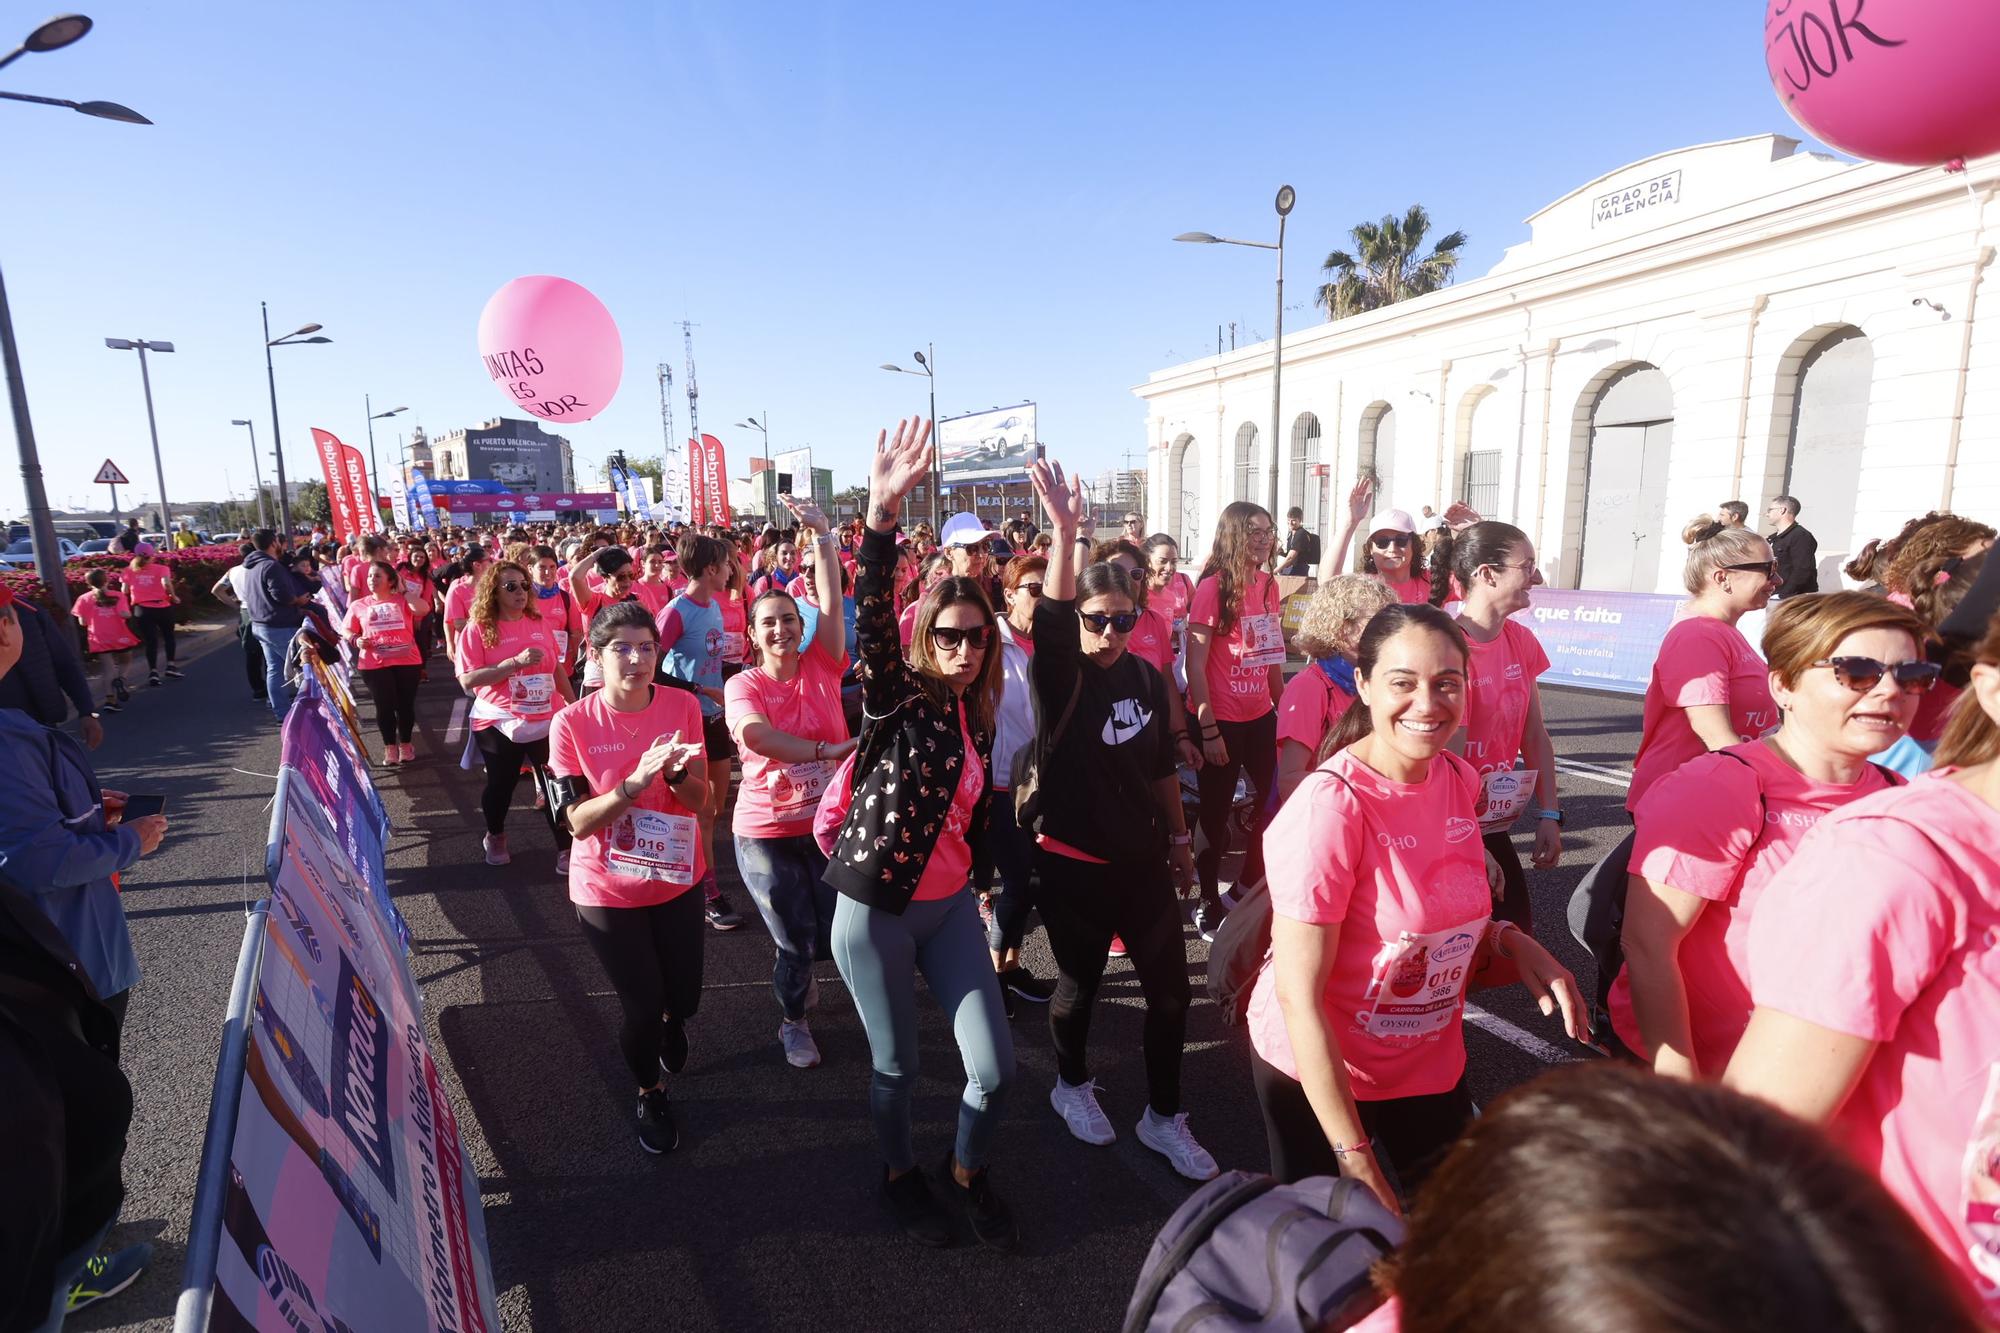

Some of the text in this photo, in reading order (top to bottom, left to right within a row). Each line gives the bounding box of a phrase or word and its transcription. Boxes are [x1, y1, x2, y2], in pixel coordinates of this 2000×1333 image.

[1649, 177, 1672, 194] DE
[1597, 190, 1673, 222] VALENCIA
[508, 381, 536, 399] ES
[481, 438, 506, 446] PUERTO
[1533, 605, 1623, 625] que falta
[1746, 711, 1768, 728] TU
[588, 742, 625, 755] OYSHO
[795, 777, 819, 792] 016
[1490, 800, 1512, 811] 016
[637, 838, 665, 852] 016
[618, 856, 640, 865] CARRERA
[641, 850, 659, 860] 3605
[1428, 966, 1462, 988] 016
[1390, 1005, 1424, 1014] CARRERA
[1380, 1019, 1421, 1029] OYSHO
[344, 975, 381, 1167] Norauto
[418, 1139, 434, 1166] a
